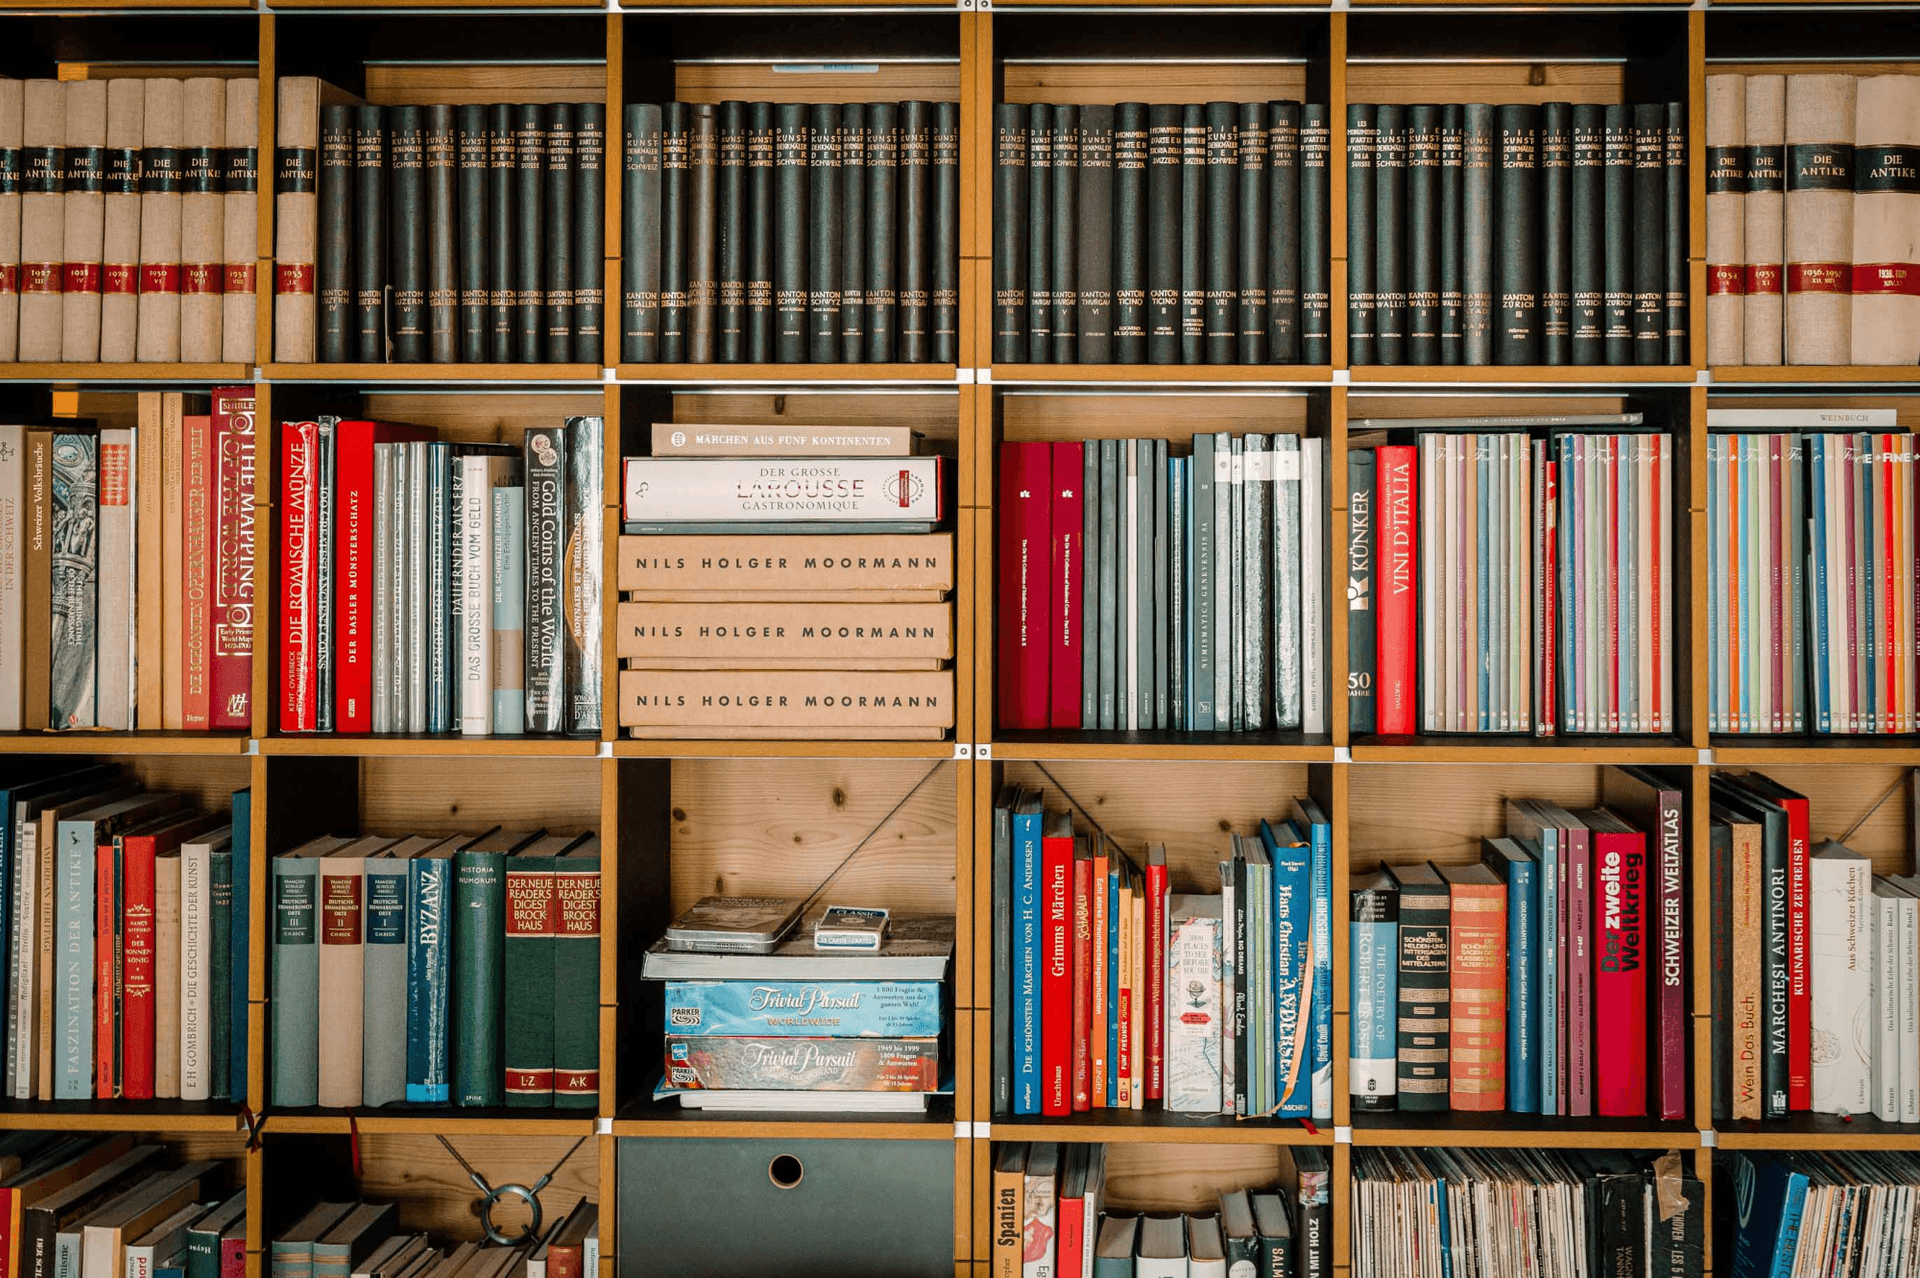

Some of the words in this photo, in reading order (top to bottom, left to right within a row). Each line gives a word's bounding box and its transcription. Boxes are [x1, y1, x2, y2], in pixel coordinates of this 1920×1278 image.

[25, 169, 64, 180] ANTIKE
[34, 158, 51, 167] DIE
[279, 170, 313, 180] ANTIKE
[286, 158, 301, 167] DIE
[627, 163, 658, 171] SCHWEIZ
[1503, 161, 1534, 169] SCHWEIZ
[1800, 167, 1845, 176] ANTIKE
[1813, 155, 1832, 164] DIE
[1869, 168, 1916, 178] ANTIKE
[1883, 155, 1903, 165] DIE
[627, 292, 656, 300] KANTON
[777, 291, 807, 299] KANTON
[777, 299, 807, 307] SCHWYZ
[1117, 290, 1145, 298] CANTON
[1118, 298, 1143, 306] TICINO
[1820, 414, 1869, 422] WEINBUCH
[191, 427, 202, 460] WELT
[695, 434, 748, 444] MÄRCHEN
[754, 436, 773, 445] AUS
[779, 434, 806, 445] FÜNF
[812, 436, 891, 446] KONTINENTEN
[33, 442, 44, 503] Volksbräuche
[191, 461, 202, 485] DER
[241, 442, 255, 486] THE
[288, 443, 304, 510] MÜNZE
[760, 468, 787, 477] DER
[791, 468, 840, 477] GROSSE
[223, 471, 237, 516] THE
[532, 481, 540, 509] FROM
[542, 480, 556, 518] Gold
[737, 479, 864, 498] LAROUSSE
[1393, 462, 1410, 546] D'ITALIA
[468, 497, 480, 529] GELD
[742, 500, 859, 511] GASTRONOMIQUE
[33, 504, 44, 551] Schweizer
[347, 490, 358, 588] MÜNSTERSCHATZ
[504, 493, 512, 554] Erfolgsgeschichte
[532, 511, 540, 555] ANCIENT
[1201, 522, 1208, 532] SA
[1351, 489, 1369, 572] KÜNKER
[189, 487, 205, 600] OPERNHÄUSER
[468, 534, 480, 560] VOM
[542, 519, 556, 569] Coins
[572, 513, 581, 568] MÉDAILLES
[222, 522, 237, 599] WORLD
[288, 514, 304, 608] RÖMISCHE
[532, 557, 540, 586] TIMES
[636, 558, 685, 569] NILS
[702, 558, 787, 569] HOLGER
[804, 557, 937, 568] MOORMANN
[1393, 551, 1410, 595] VINI
[468, 564, 480, 598] BUCH
[542, 570, 556, 586] of
[532, 588, 540, 602] TO
[542, 587, 556, 615] the
[290, 615, 304, 645] DIE
[349, 593, 357, 635] BASLER
[468, 603, 480, 651] GROSSE
[532, 604, 540, 624] THE
[188, 602, 202, 672] SCHÖNSTEN
[532, 625, 540, 668] PRESENT
[542, 616, 556, 668] World
[634, 626, 683, 637] NILS
[700, 626, 785, 637] HOLGER
[802, 626, 934, 638] MOORMANN
[349, 640, 357, 663] DER
[468, 656, 480, 681] DAS
[1348, 672, 1370, 689] 50
[637, 695, 685, 706] NILS
[702, 695, 788, 706] HOLGER
[805, 695, 937, 707] MOORMANN
[1023, 840, 1033, 890] ANDERSEN
[1664, 808, 1679, 895] WELTATLAS
[43, 845, 51, 899] AMERICAN
[69, 849, 82, 913] ANTIKE
[188, 855, 198, 890] KUNST
[459, 877, 496, 885] NUMORUM
[461, 866, 494, 874] HISTORIA
[508, 879, 527, 888] DER
[528, 879, 554, 889] NEUE
[1794, 839, 1803, 906] ZEITREISEN
[1846, 866, 1856, 902] Küchen
[188, 891, 197, 911] DER
[514, 900, 547, 909] DIGEST
[1051, 864, 1065, 921] Märchen
[1279, 885, 1292, 918] Hans
[1600, 851, 1621, 930] zweite
[420, 870, 439, 945] BYZANZ
[1620, 852, 1643, 973] Weltkrieg
[1772, 867, 1786, 956] ANTINORI
[43, 902, 51, 954] HERITAGE
[69, 919, 81, 953] DER
[518, 921, 543, 930] HAUS
[1024, 926, 1033, 944] VON
[1665, 897, 1680, 987] SCHWEIZER
[1847, 902, 1856, 953] Schweizer
[187, 914, 197, 979] GESCHICHTE
[1052, 924, 1065, 977] Grimms
[1151, 909, 1162, 1003] Weihnachtsgeschichten
[1279, 920, 1293, 976] Christian
[1358, 932, 1374, 993] ROBERT
[1377, 944, 1386, 968] THE
[1600, 930, 1621, 974] Der
[1794, 910, 1804, 996] KULINARISCHE
[1848, 954, 1856, 971] Aus
[1023, 949, 1033, 995] MÄRCHEN
[1095, 919, 1103, 1015] Freundschaftsgeschichten
[187, 981, 197, 998] DIE
[749, 987, 801, 1011] Trivial
[796, 986, 861, 1015] Pursuit
[1376, 973, 1386, 1024] POETRY
[67, 960, 80, 1074] FASZINATION
[672, 1008, 700, 1016] PARKER
[766, 1017, 840, 1026] WORLDWIDE
[1741, 991, 1756, 1029] Buch.
[1772, 962, 1786, 1055] MARCHESI
[187, 1007, 197, 1067] GOMBRICH
[1024, 999, 1033, 1053] SCHÖNSTEN
[1358, 1000, 1373, 1052] FROST
[1376, 1026, 1386, 1041] OF
[741, 1043, 800, 1067] Trivial
[794, 1043, 857, 1074] Pursuit
[1023, 1055, 1033, 1074] DIE
[1054, 1065, 1062, 1107] Urachhaus
[998, 1188, 1015, 1247] Spanien
[1309, 1218, 1320, 1243] HOLZ
[1309, 1245, 1319, 1270] MIT
